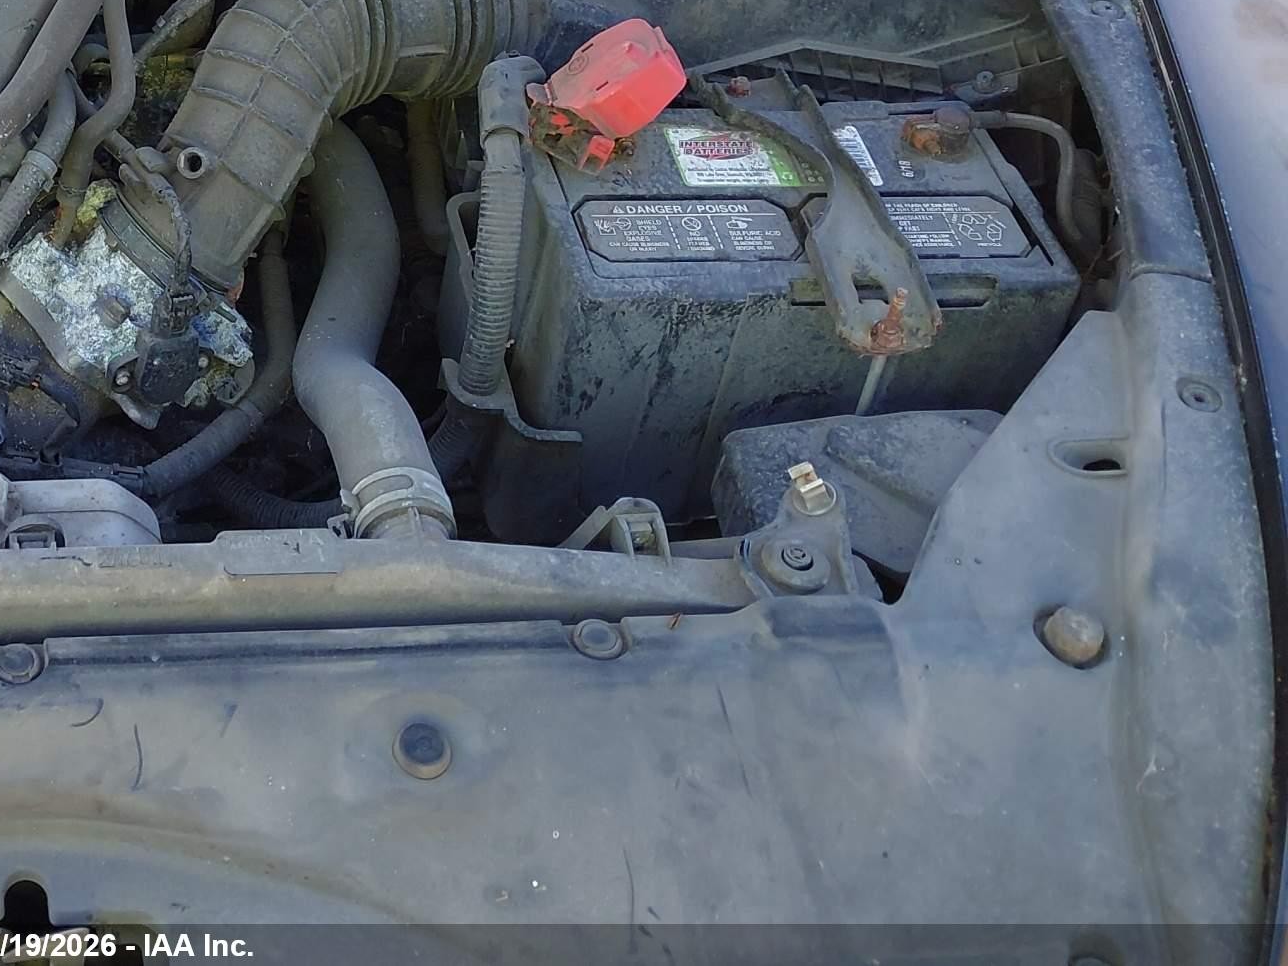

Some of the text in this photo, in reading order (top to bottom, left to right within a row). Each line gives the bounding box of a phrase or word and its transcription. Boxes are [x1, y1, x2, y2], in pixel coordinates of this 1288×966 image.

[679, 140, 755, 148] INTERSTATE
[626, 205, 683, 214] DANGER
[696, 204, 749, 213] POISON
